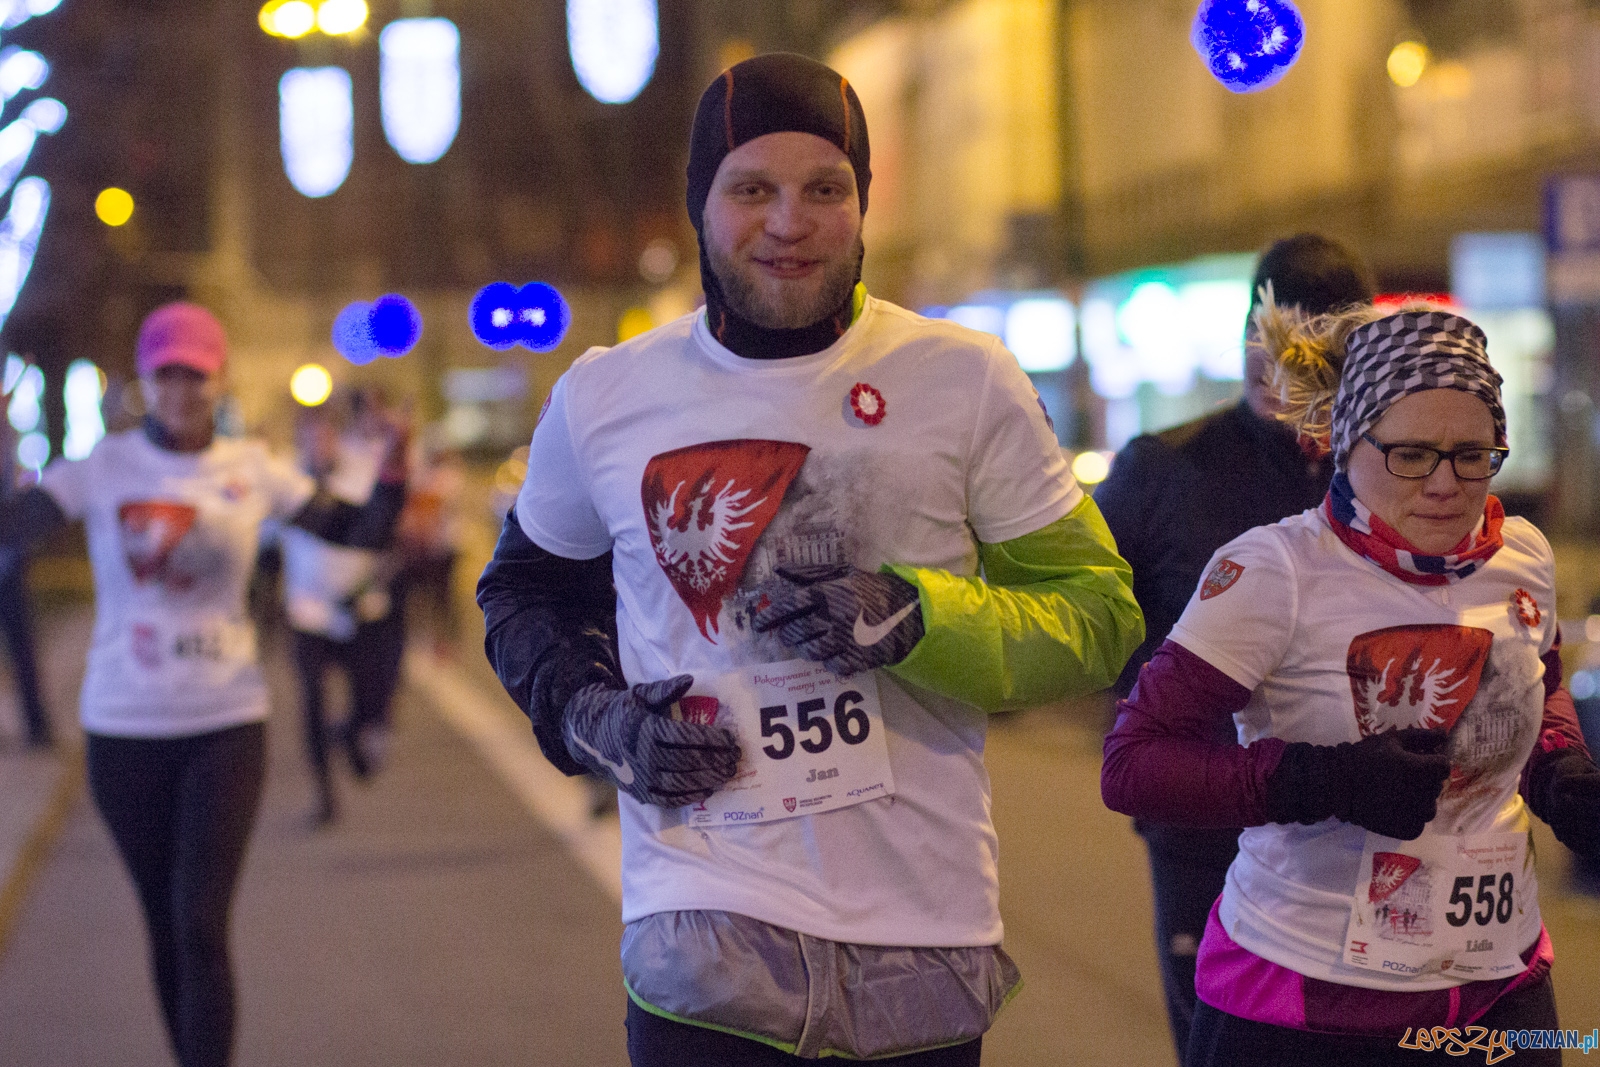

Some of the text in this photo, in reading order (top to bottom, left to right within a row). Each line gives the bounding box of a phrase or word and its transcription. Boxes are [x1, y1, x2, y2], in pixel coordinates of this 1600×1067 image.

[788, 681, 816, 695] mamy
[760, 690, 870, 760] 556
[806, 767, 840, 783] Jan
[1445, 872, 1514, 927] 558
[1465, 939, 1494, 953] Lidia
